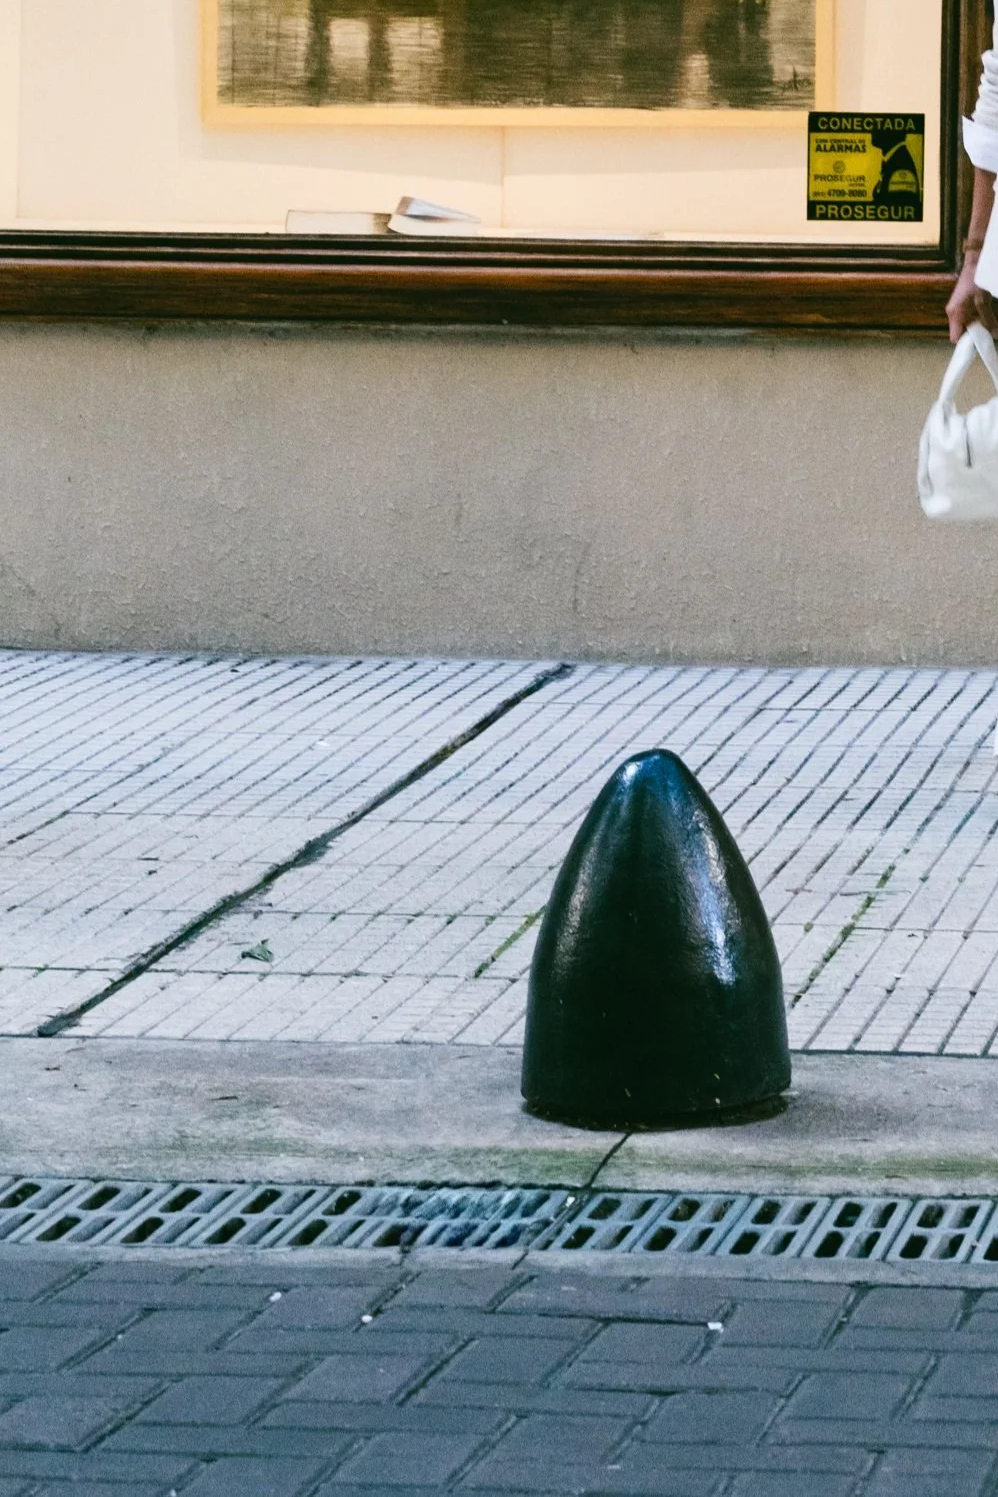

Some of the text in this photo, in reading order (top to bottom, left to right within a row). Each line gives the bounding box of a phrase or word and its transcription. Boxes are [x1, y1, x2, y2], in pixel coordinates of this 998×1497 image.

[818, 117, 915, 130] CONECTADA
[815, 144, 866, 153] ALARMAS
[815, 205, 915, 219] PROSEGUR
